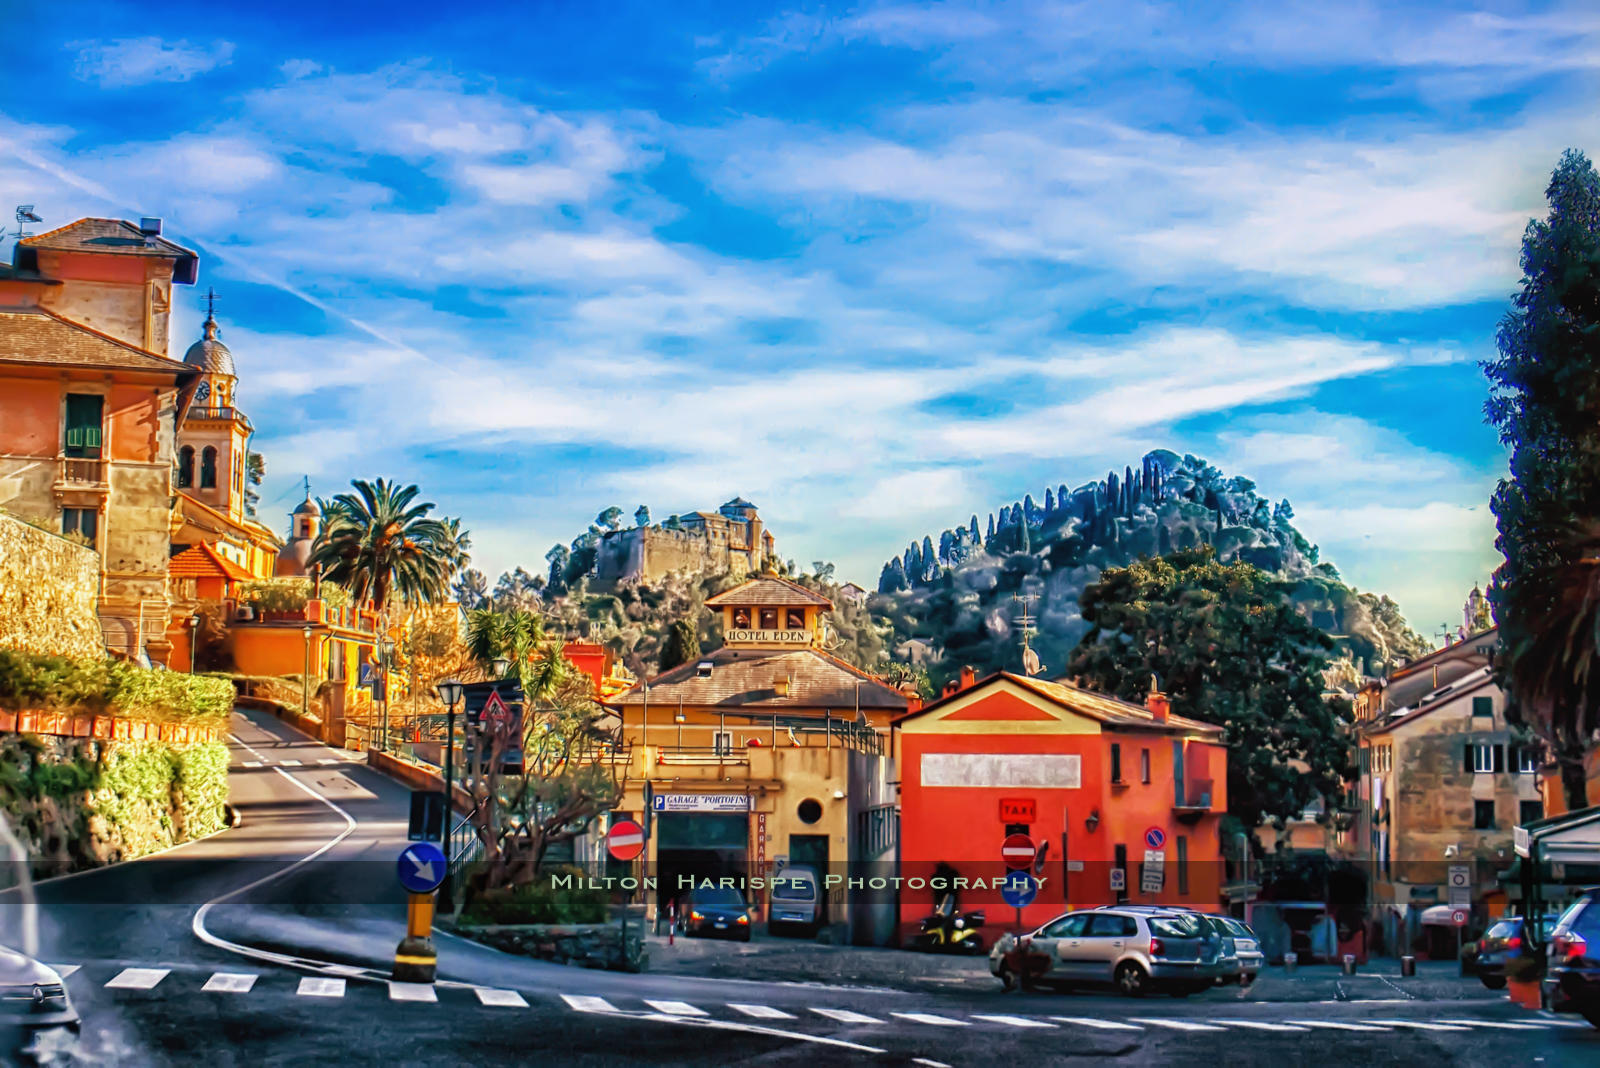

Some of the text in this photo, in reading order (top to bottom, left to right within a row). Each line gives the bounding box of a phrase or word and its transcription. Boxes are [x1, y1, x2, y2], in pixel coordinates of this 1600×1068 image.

[729, 631, 805, 641] HOTEL EDEN
[655, 797, 663, 809] P
[667, 796, 699, 804] GARAGE
